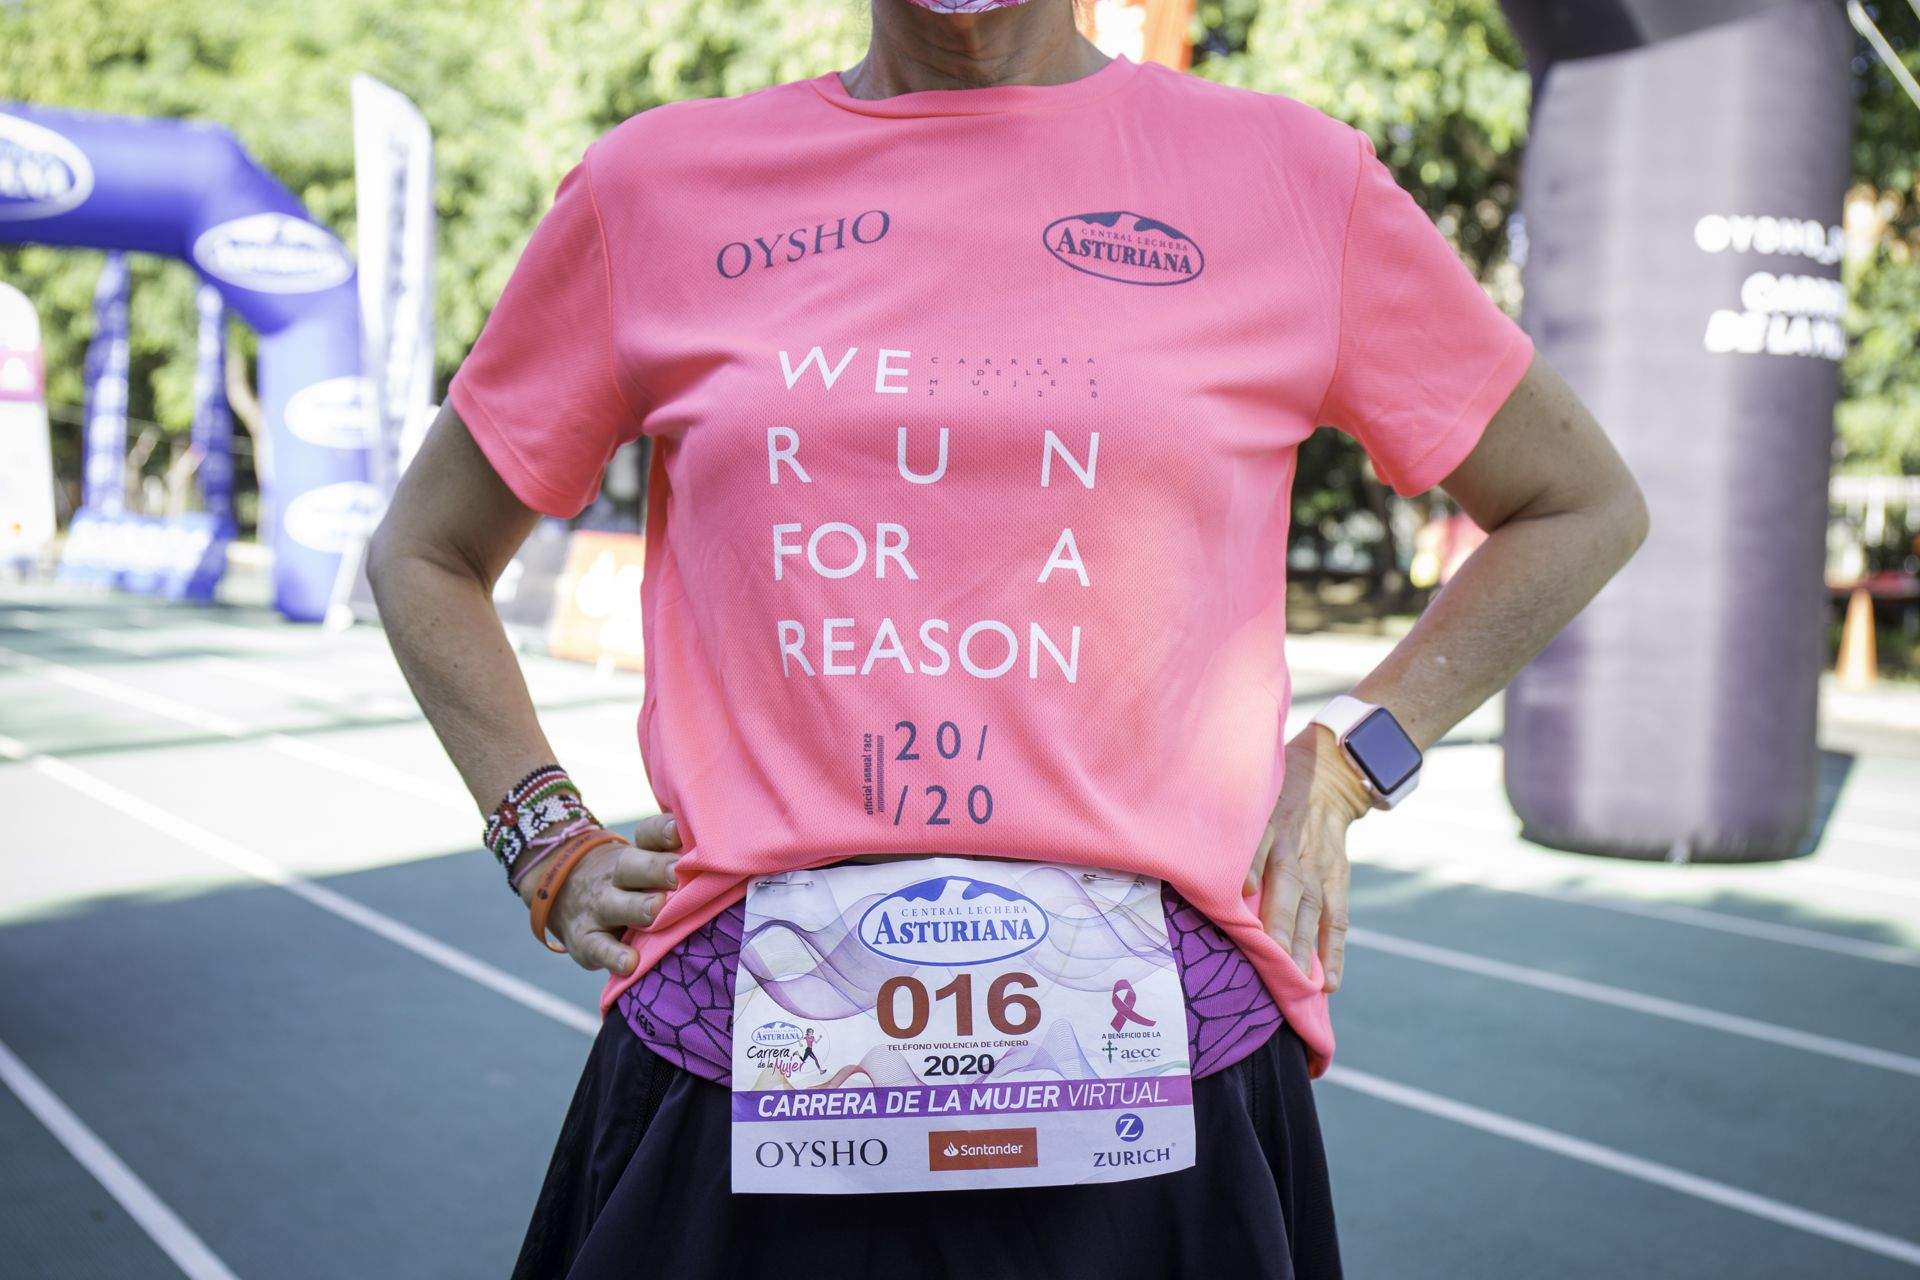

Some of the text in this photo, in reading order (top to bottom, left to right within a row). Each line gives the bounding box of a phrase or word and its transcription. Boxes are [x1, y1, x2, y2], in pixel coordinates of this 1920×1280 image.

[716, 209, 891, 279] OYSHO
[1056, 227, 1192, 274] ASTURIANA
[1081, 228, 1188, 251] CENTRAL LECHERA
[778, 346, 911, 394] WE
[767, 426, 1100, 489] RUN
[773, 522, 1091, 587] FOR A
[777, 617, 1081, 684] REASON
[861, 733, 873, 815] official annual race
[901, 905, 1029, 917] CENTRAL LECHERA
[872, 911, 1036, 945] ASTURIANA
[876, 972, 1042, 1039] 016
[756, 1032, 800, 1041] ASTURIANA
[887, 1038, 1029, 1051] TELÉFONO VIOLENCIA DE GÉNERO
[1108, 1031, 1141, 1039] BENEFICIO
[746, 1045, 790, 1059] Carrera
[923, 1053, 995, 1077] 2020
[1121, 1048, 1161, 1059] aecc
[757, 1057, 805, 1078] de la Mujer
[758, 1081, 1169, 1118] CARRERA DE LA MUJER VIRTUAL
[755, 1138, 889, 1168] OYSHO
[960, 1143, 1024, 1156] Santander
[1093, 1147, 1171, 1167] ZURICH
